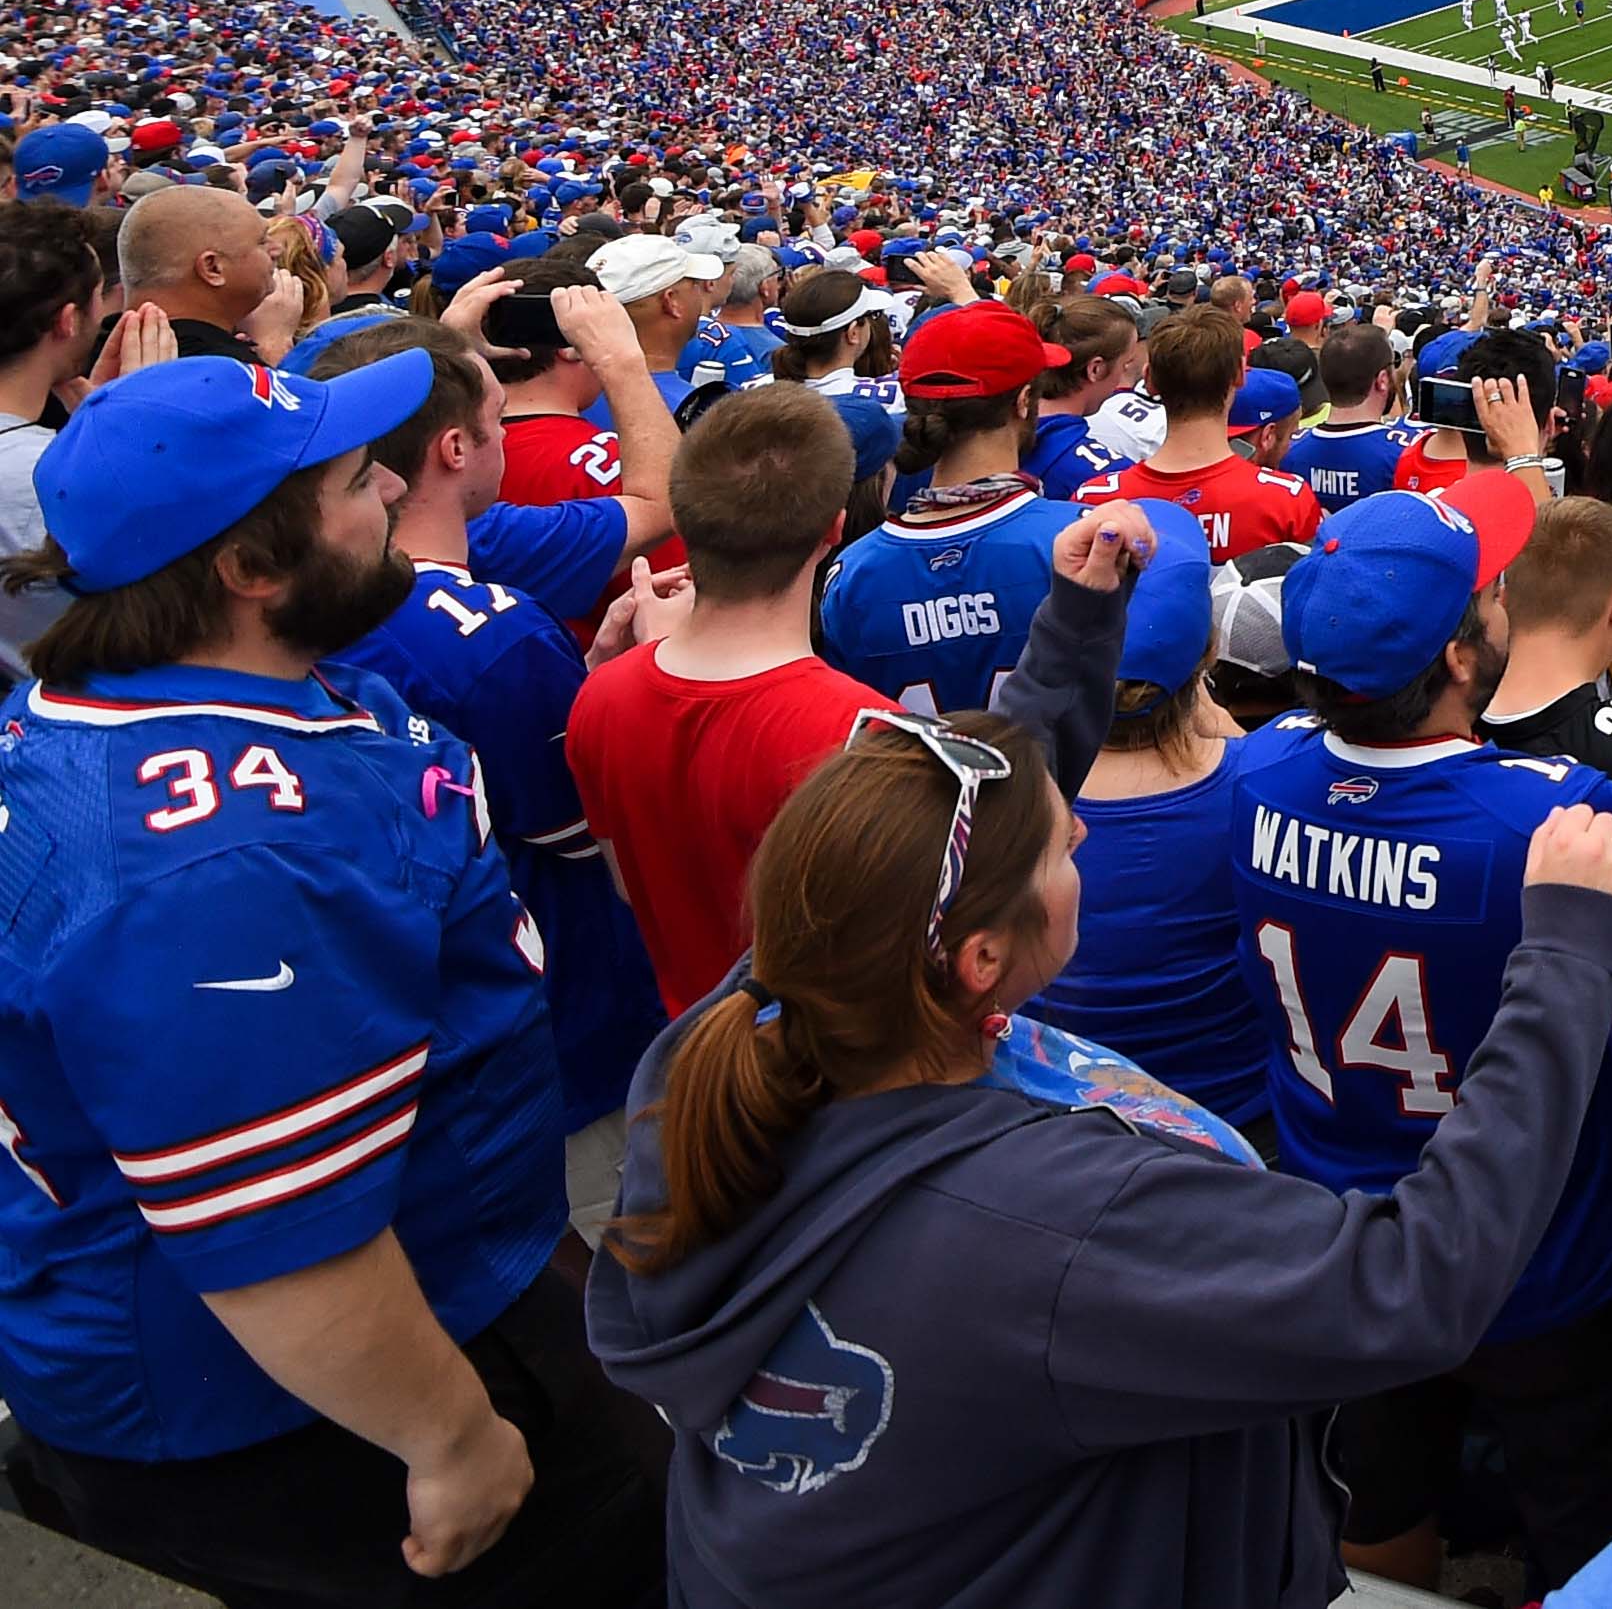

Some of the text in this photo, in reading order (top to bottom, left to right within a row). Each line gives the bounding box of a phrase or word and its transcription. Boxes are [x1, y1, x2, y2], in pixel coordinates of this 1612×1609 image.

[1309, 468, 1361, 496] WHITE
[901, 592, 1001, 647] DIGGS
[137, 742, 306, 831] 34
[1250, 803, 1442, 911] WATKINS
[1255, 920, 1458, 1114] 14
